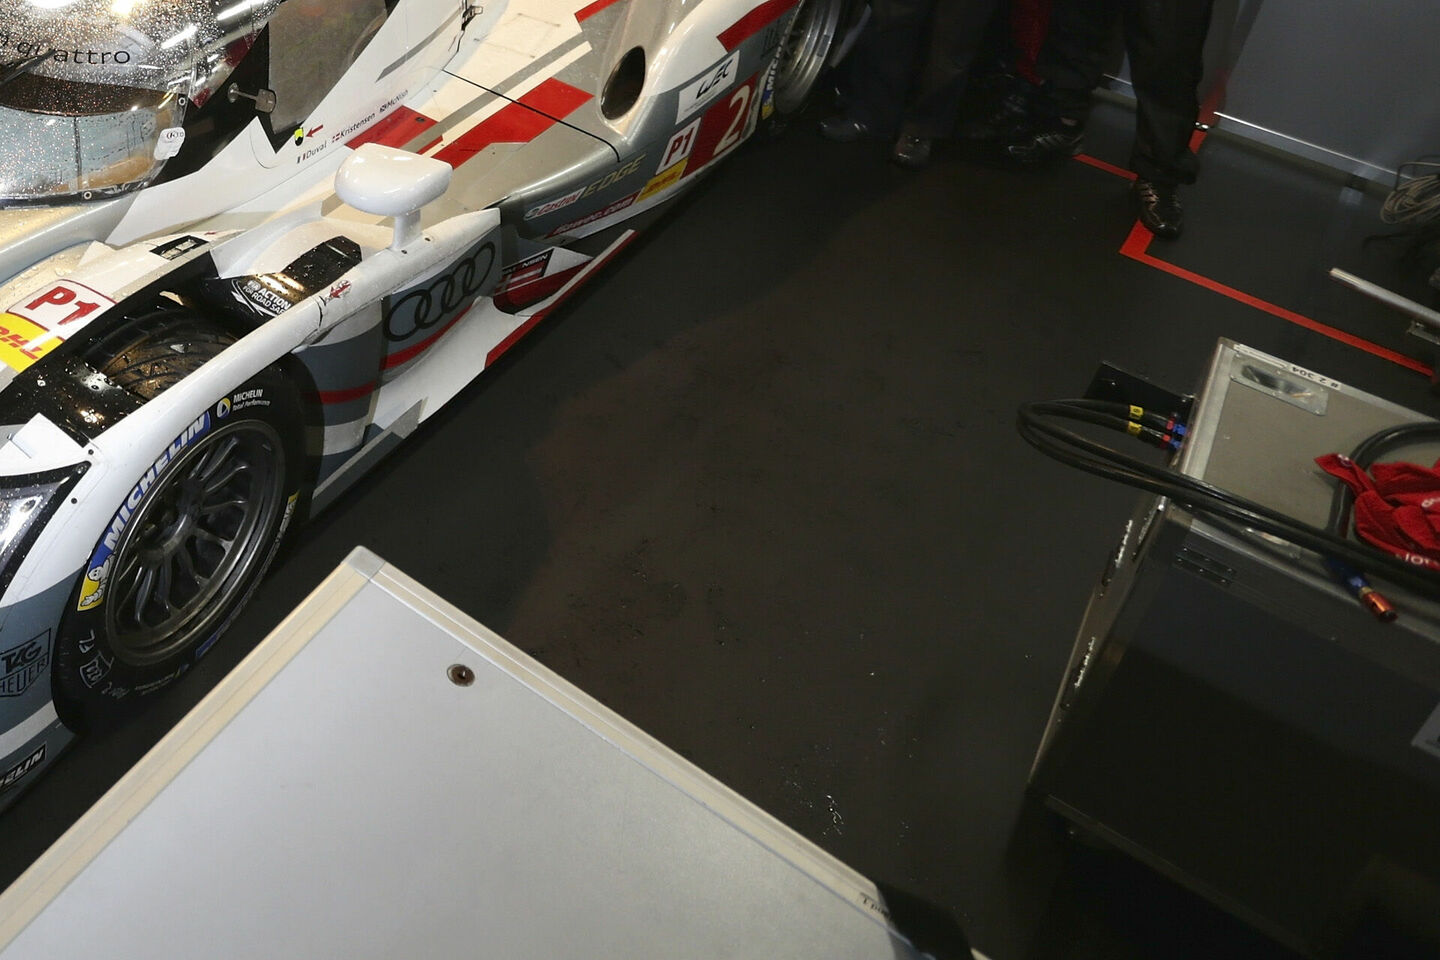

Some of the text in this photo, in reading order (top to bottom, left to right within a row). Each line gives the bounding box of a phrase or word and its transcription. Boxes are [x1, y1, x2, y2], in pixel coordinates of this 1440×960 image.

[696, 58, 733, 100] WEC
[306, 140, 327, 159] Duval
[339, 112, 376, 139] Kristensen
[712, 84, 750, 157] 2
[663, 127, 694, 167] P1
[581, 153, 647, 199] EDGE
[25, 285, 101, 326] P1
[252, 292, 273, 308] ROAD
[259, 287, 292, 310] ACTION
[234, 388, 264, 403] MICHELIN
[104, 414, 207, 552] MICHELIN
[1, 641, 42, 674] TAG
